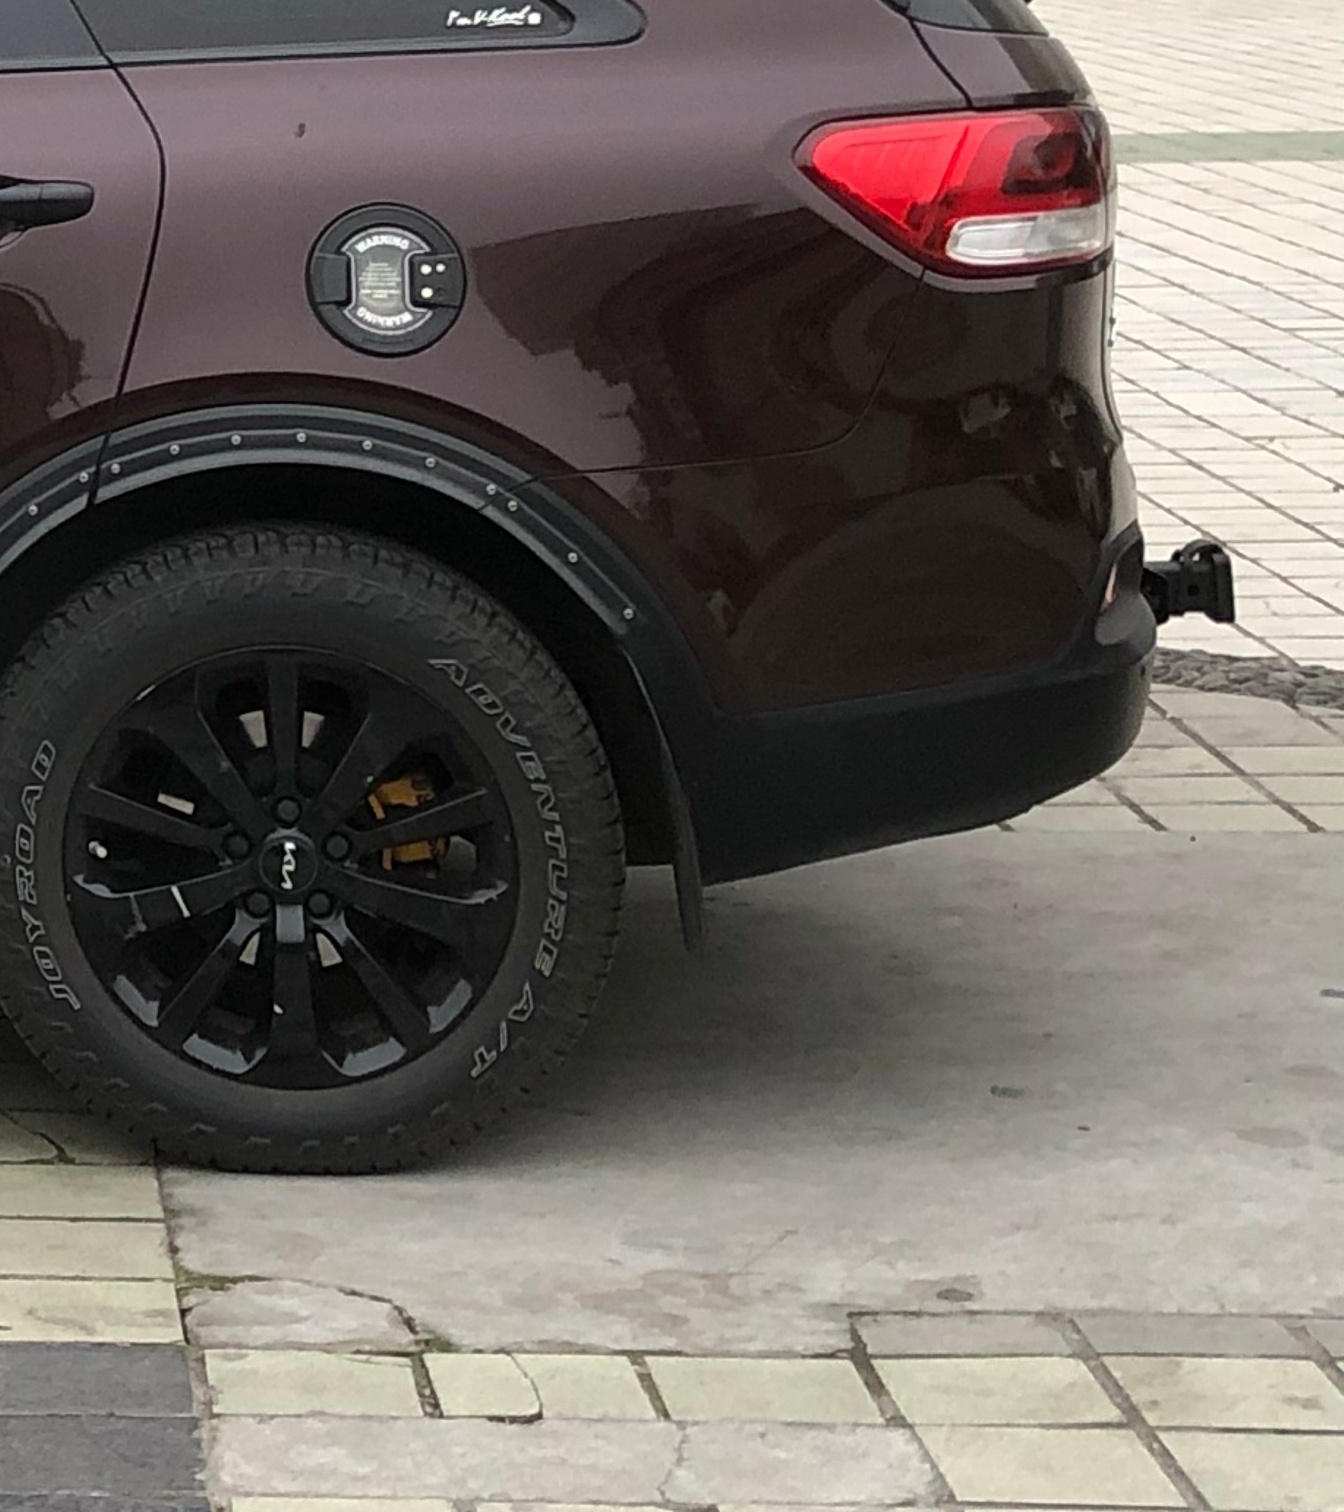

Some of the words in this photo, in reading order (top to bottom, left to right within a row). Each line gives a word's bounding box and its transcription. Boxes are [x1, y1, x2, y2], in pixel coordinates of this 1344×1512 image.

[14, 740, 81, 1011] JOYROAD
[428, 657, 570, 978] ADVENTURE
[469, 981, 536, 1080] A/T
